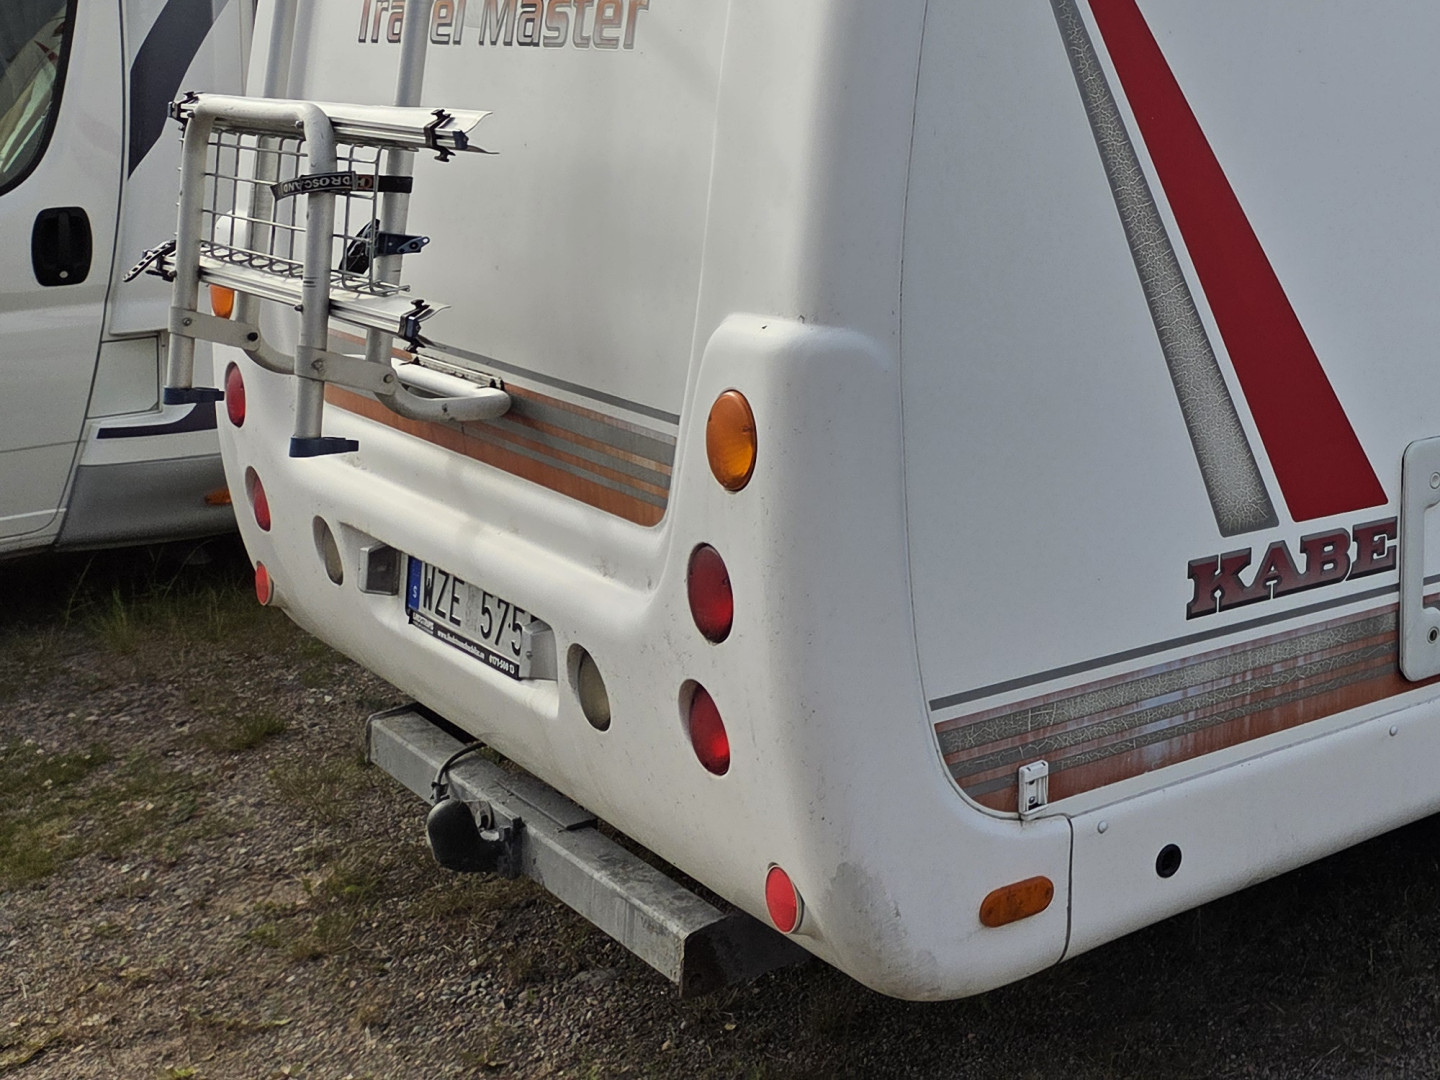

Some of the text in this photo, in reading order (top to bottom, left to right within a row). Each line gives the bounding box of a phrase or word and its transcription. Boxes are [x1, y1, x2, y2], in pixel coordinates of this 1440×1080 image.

[282, 176, 366, 193] HDROSCAND
[412, 585, 418, 599] S
[1186, 516, 1398, 621] KABE
[423, 562, 465, 627] WZE
[480, 590, 526, 656] 575
